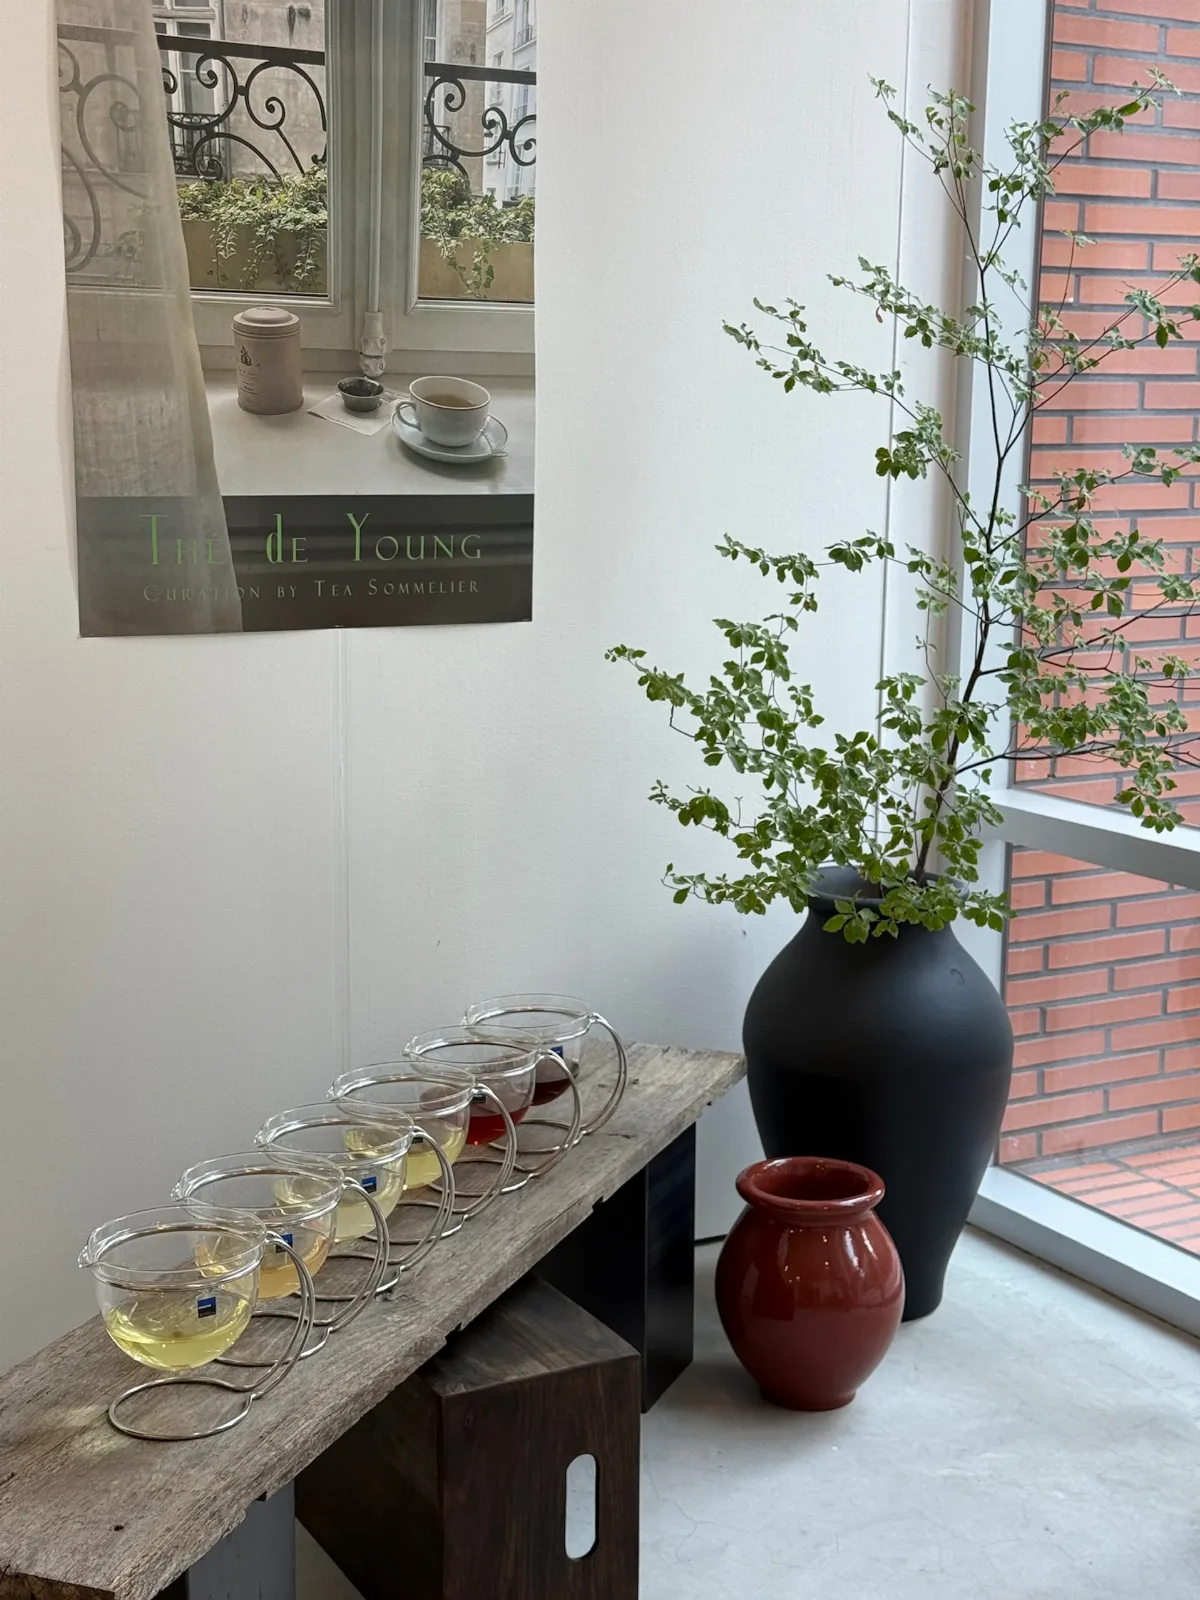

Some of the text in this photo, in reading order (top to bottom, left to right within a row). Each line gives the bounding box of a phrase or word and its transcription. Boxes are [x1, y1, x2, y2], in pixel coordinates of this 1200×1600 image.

[346, 512, 481, 561] YOUNG
[277, 585, 297, 598] BY
[313, 579, 352, 597] TEA
[368, 578, 479, 596] SOMMELIER
